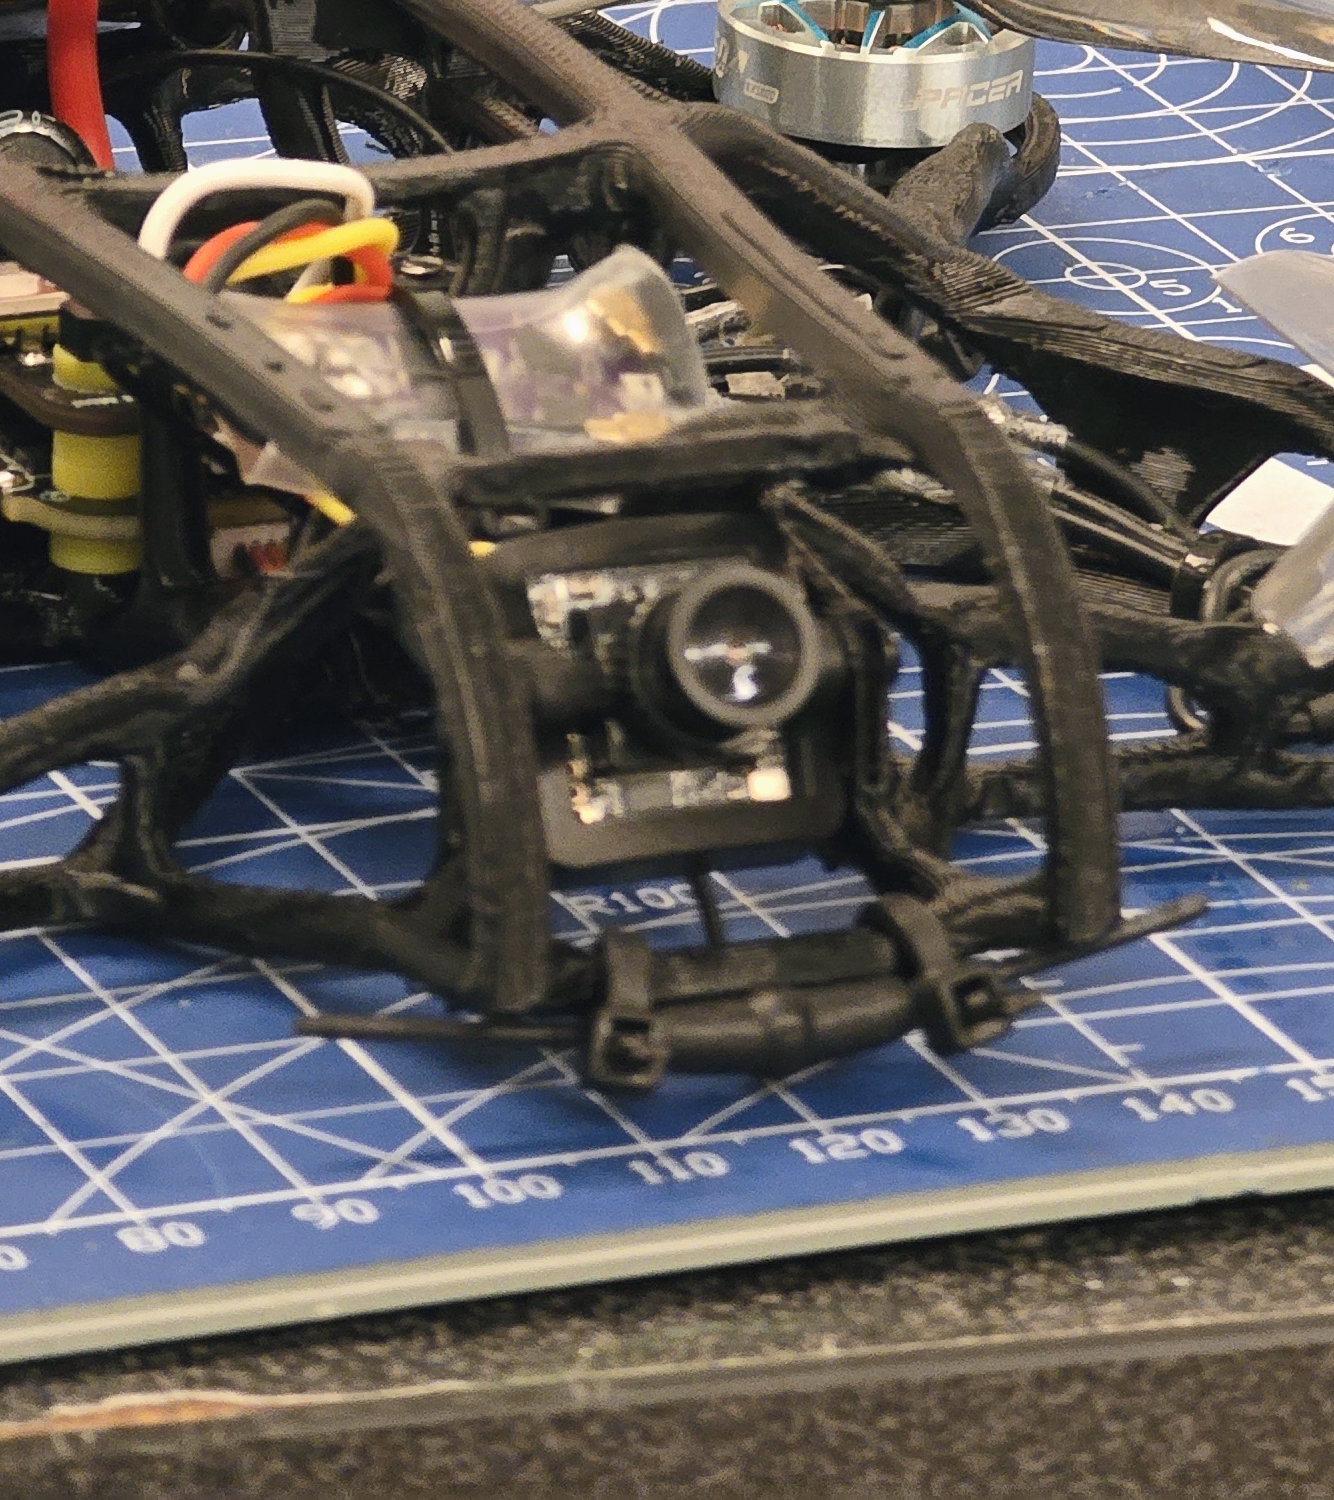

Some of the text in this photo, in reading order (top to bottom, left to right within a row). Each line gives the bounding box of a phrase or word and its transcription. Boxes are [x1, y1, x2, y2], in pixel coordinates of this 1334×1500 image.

[1279, 227, 1315, 244] 6
[1149, 278, 1193, 297] 5
[115, 1220, 206, 1254] 80
[290, 1197, 380, 1230] 90
[452, 1173, 564, 1209] 100
[628, 1151, 731, 1186] 110
[788, 1127, 906, 1164] 120
[956, 1107, 1072, 1142] 130
[1121, 1086, 1236, 1122] 140
